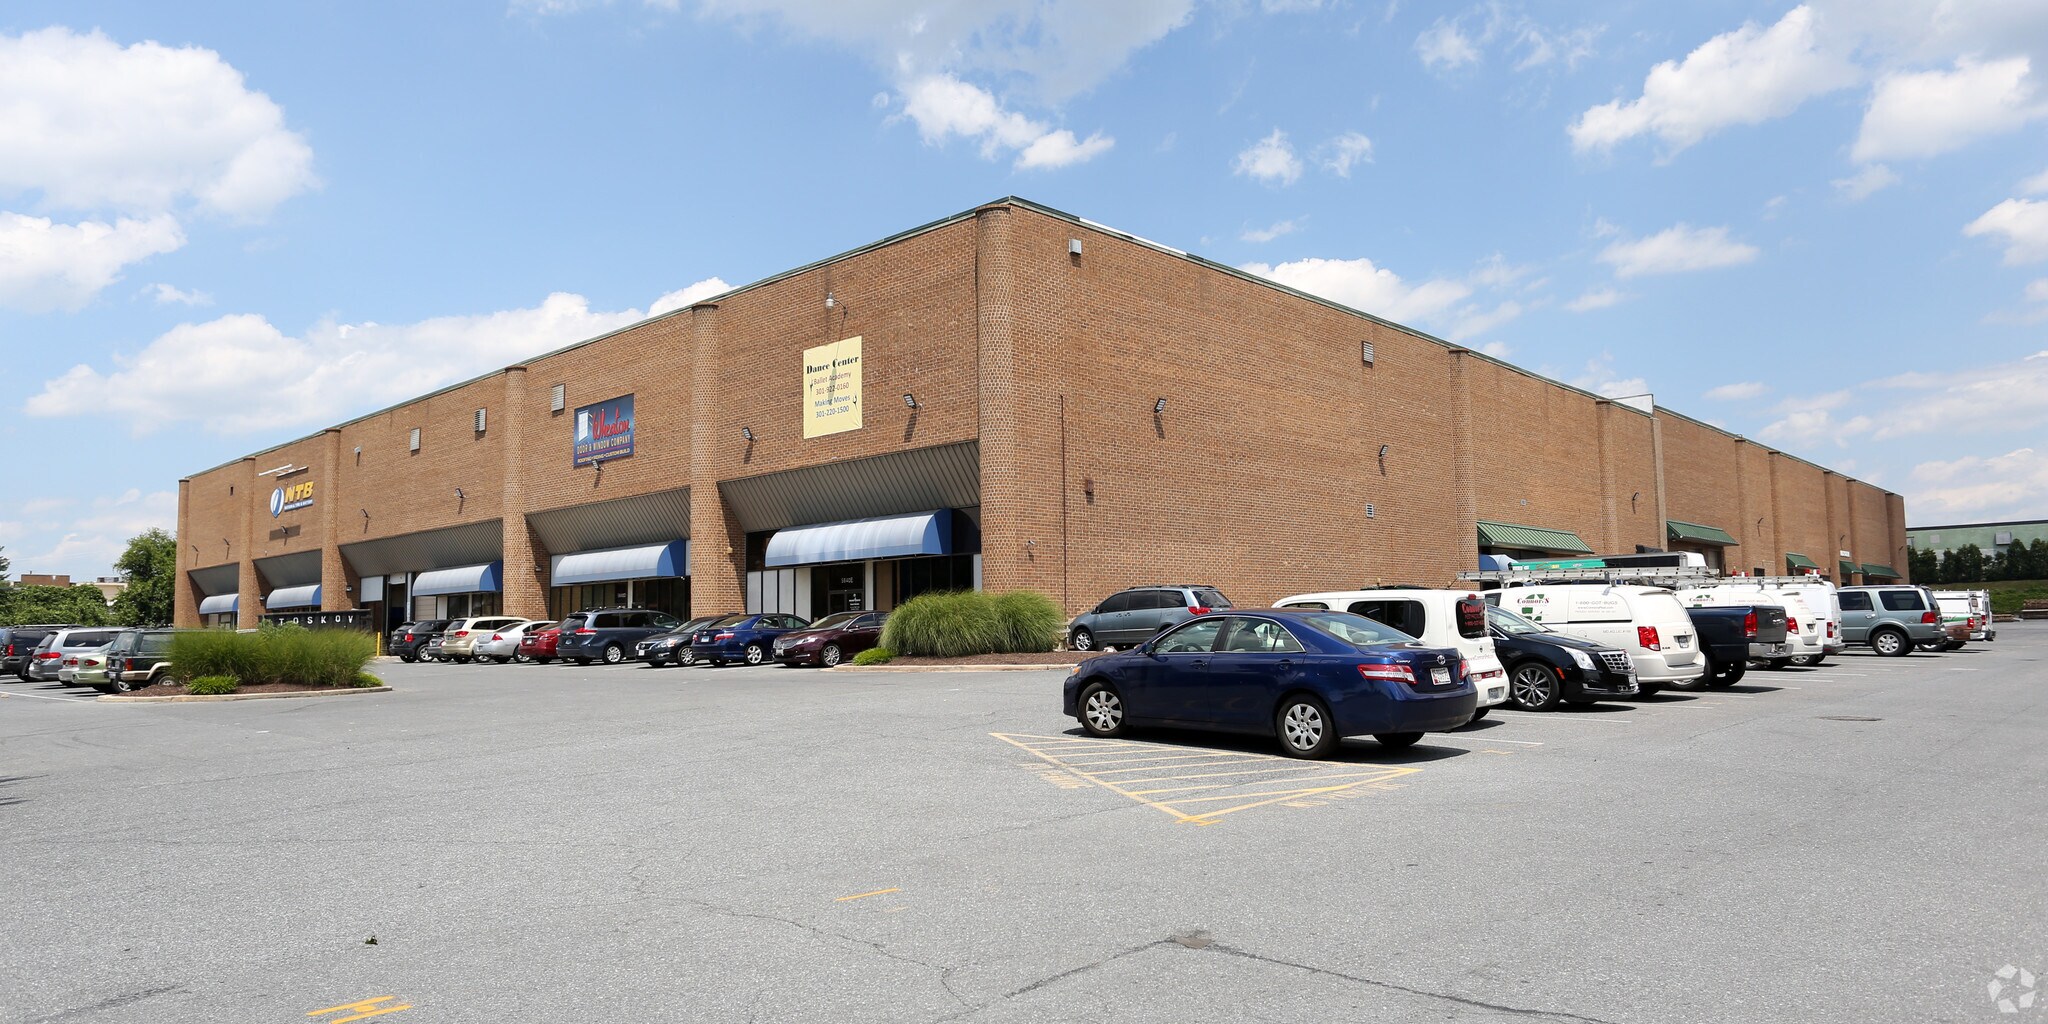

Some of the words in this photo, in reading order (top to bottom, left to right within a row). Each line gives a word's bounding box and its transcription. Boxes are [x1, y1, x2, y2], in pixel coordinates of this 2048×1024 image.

[806, 364, 830, 374] Dance
[832, 357, 859, 367] Center
[814, 377, 828, 385] Ballet
[829, 372, 851, 380] Academy
[834, 395, 850, 403] Moves
[816, 406, 849, 418] 301-220-1500
[592, 406, 630, 440] Wheaton
[577, 445, 587, 454] DOOR
[593, 440, 610, 450] WINDOW
[611, 435, 630, 446] COMPANY
[284, 481, 314, 503] NTB
